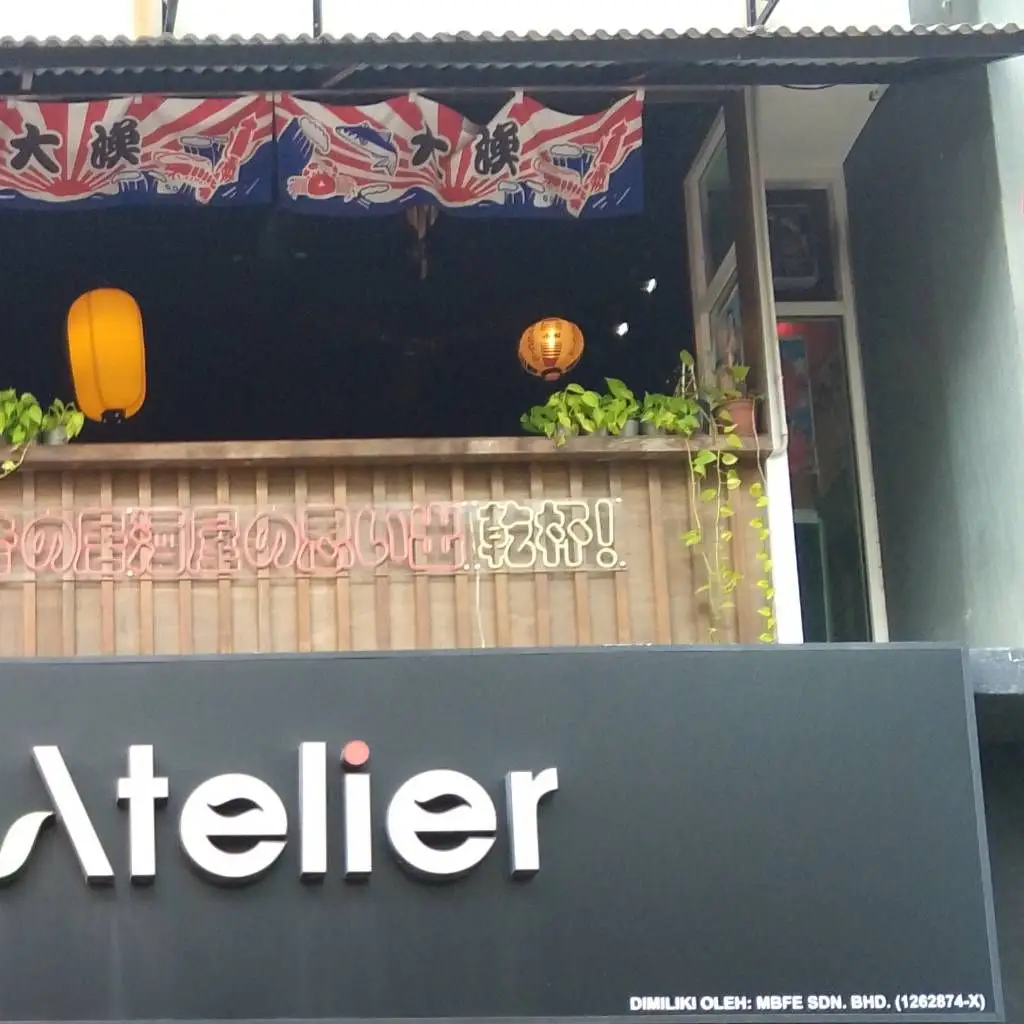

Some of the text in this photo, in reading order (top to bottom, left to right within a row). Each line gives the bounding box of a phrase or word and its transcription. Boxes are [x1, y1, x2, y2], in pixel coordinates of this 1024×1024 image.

[630, 993, 986, 1011] DIMILIKI OLEH: MBFE SDN. BHD. (1262874-X)
